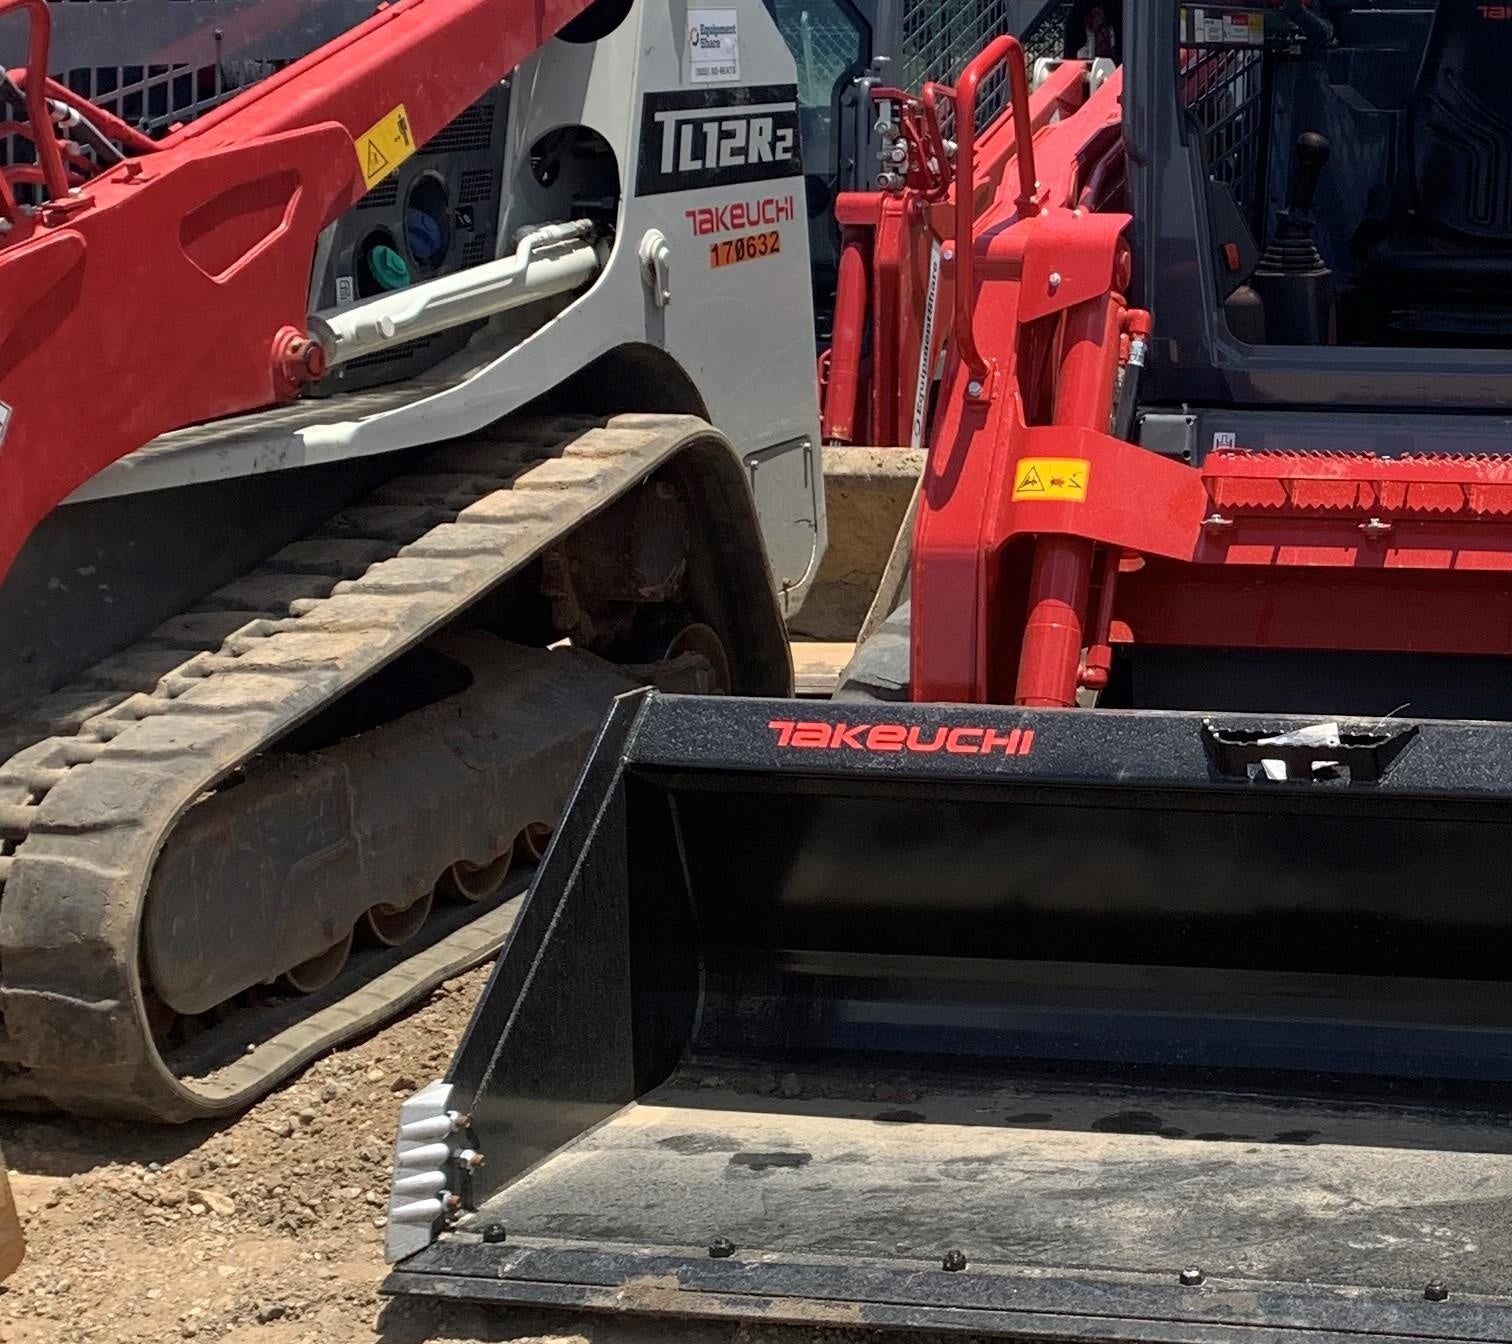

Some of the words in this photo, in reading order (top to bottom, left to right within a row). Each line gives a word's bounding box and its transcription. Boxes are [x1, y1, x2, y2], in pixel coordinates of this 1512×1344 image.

[654, 101, 797, 174] TL12R2
[685, 195, 794, 236] TAKEUCHI
[711, 230, 780, 267] 170632
[768, 720, 1035, 756] TAKEUCHI
